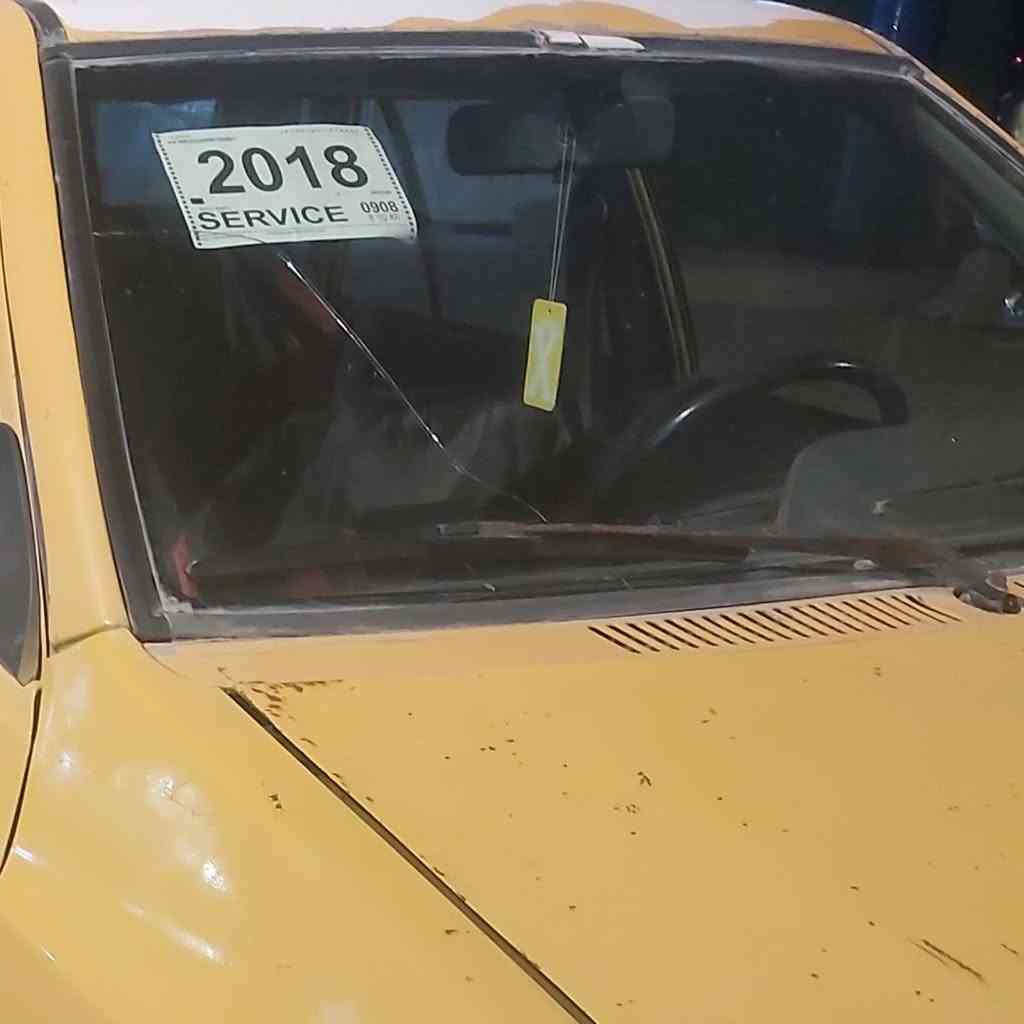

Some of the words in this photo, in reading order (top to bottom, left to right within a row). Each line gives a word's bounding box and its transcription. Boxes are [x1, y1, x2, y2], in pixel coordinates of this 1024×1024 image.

[197, 145, 368, 194] 2018
[198, 205, 348, 230] SERVICE
[360, 200, 398, 213] 0908
